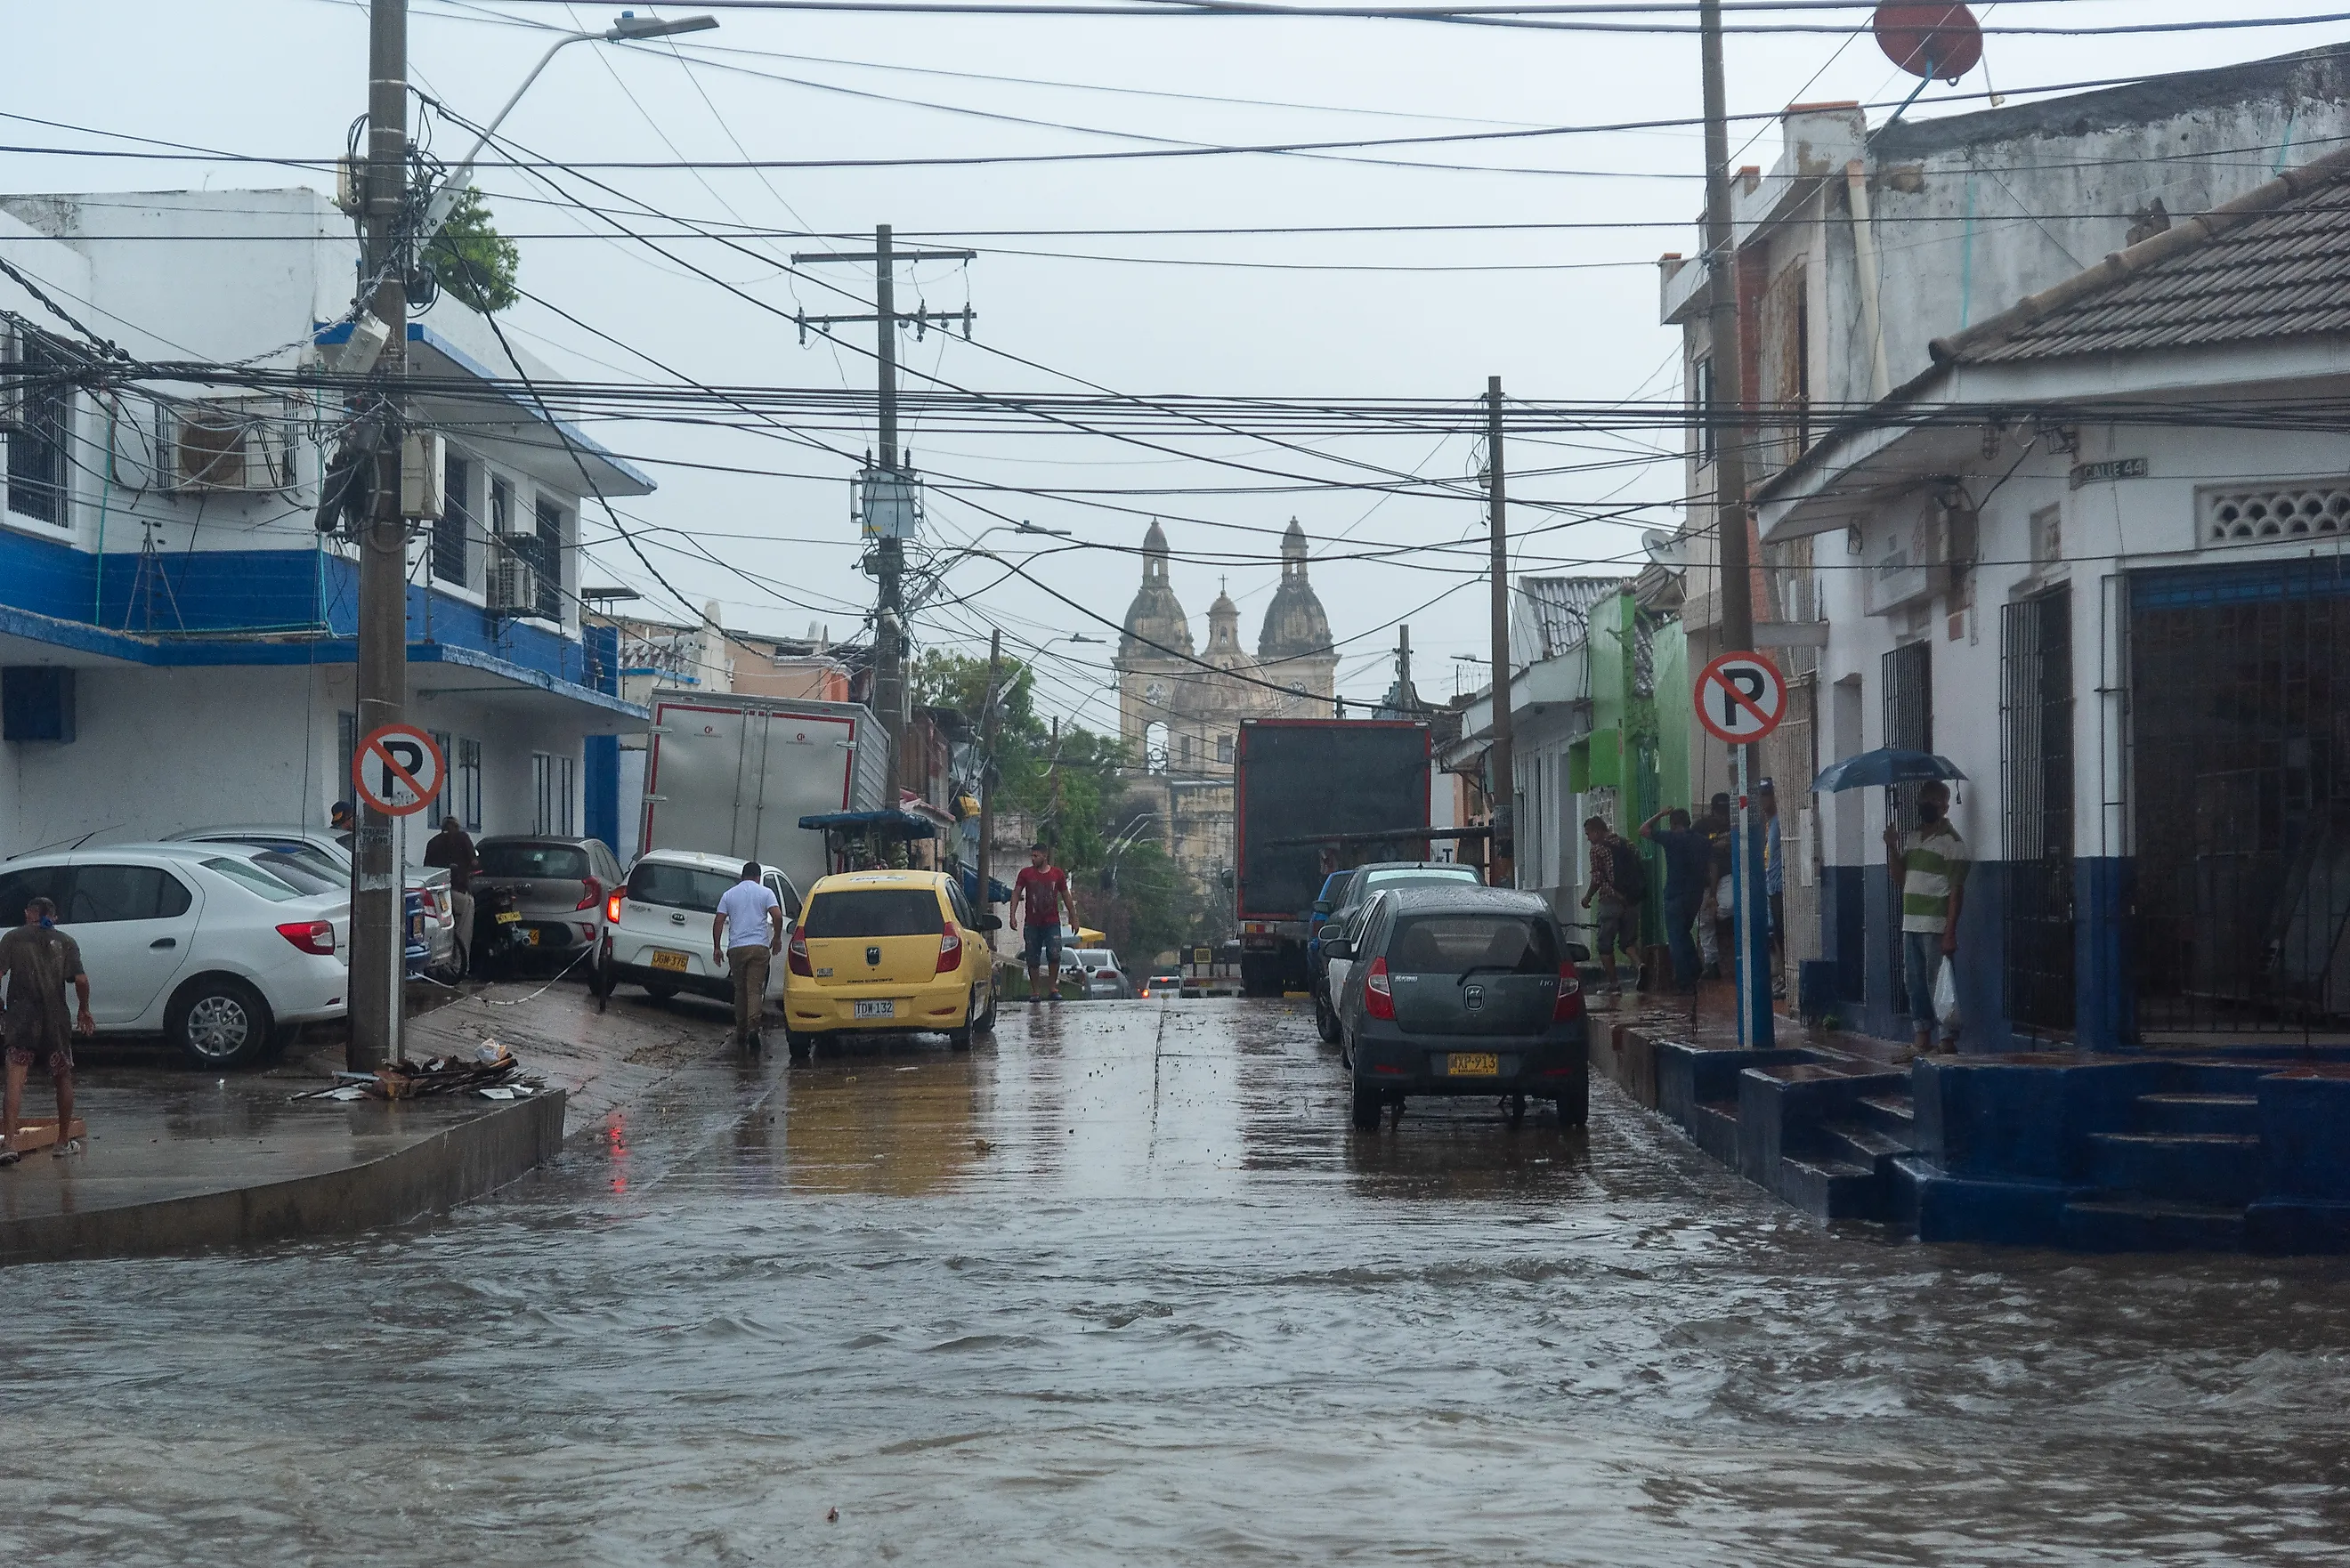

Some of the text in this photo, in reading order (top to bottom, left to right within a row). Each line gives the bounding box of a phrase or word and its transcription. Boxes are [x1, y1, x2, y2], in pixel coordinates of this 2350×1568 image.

[2084, 460, 2143, 478] CALLE 44
[1723, 668, 1765, 726] P
[383, 741, 423, 798] P
